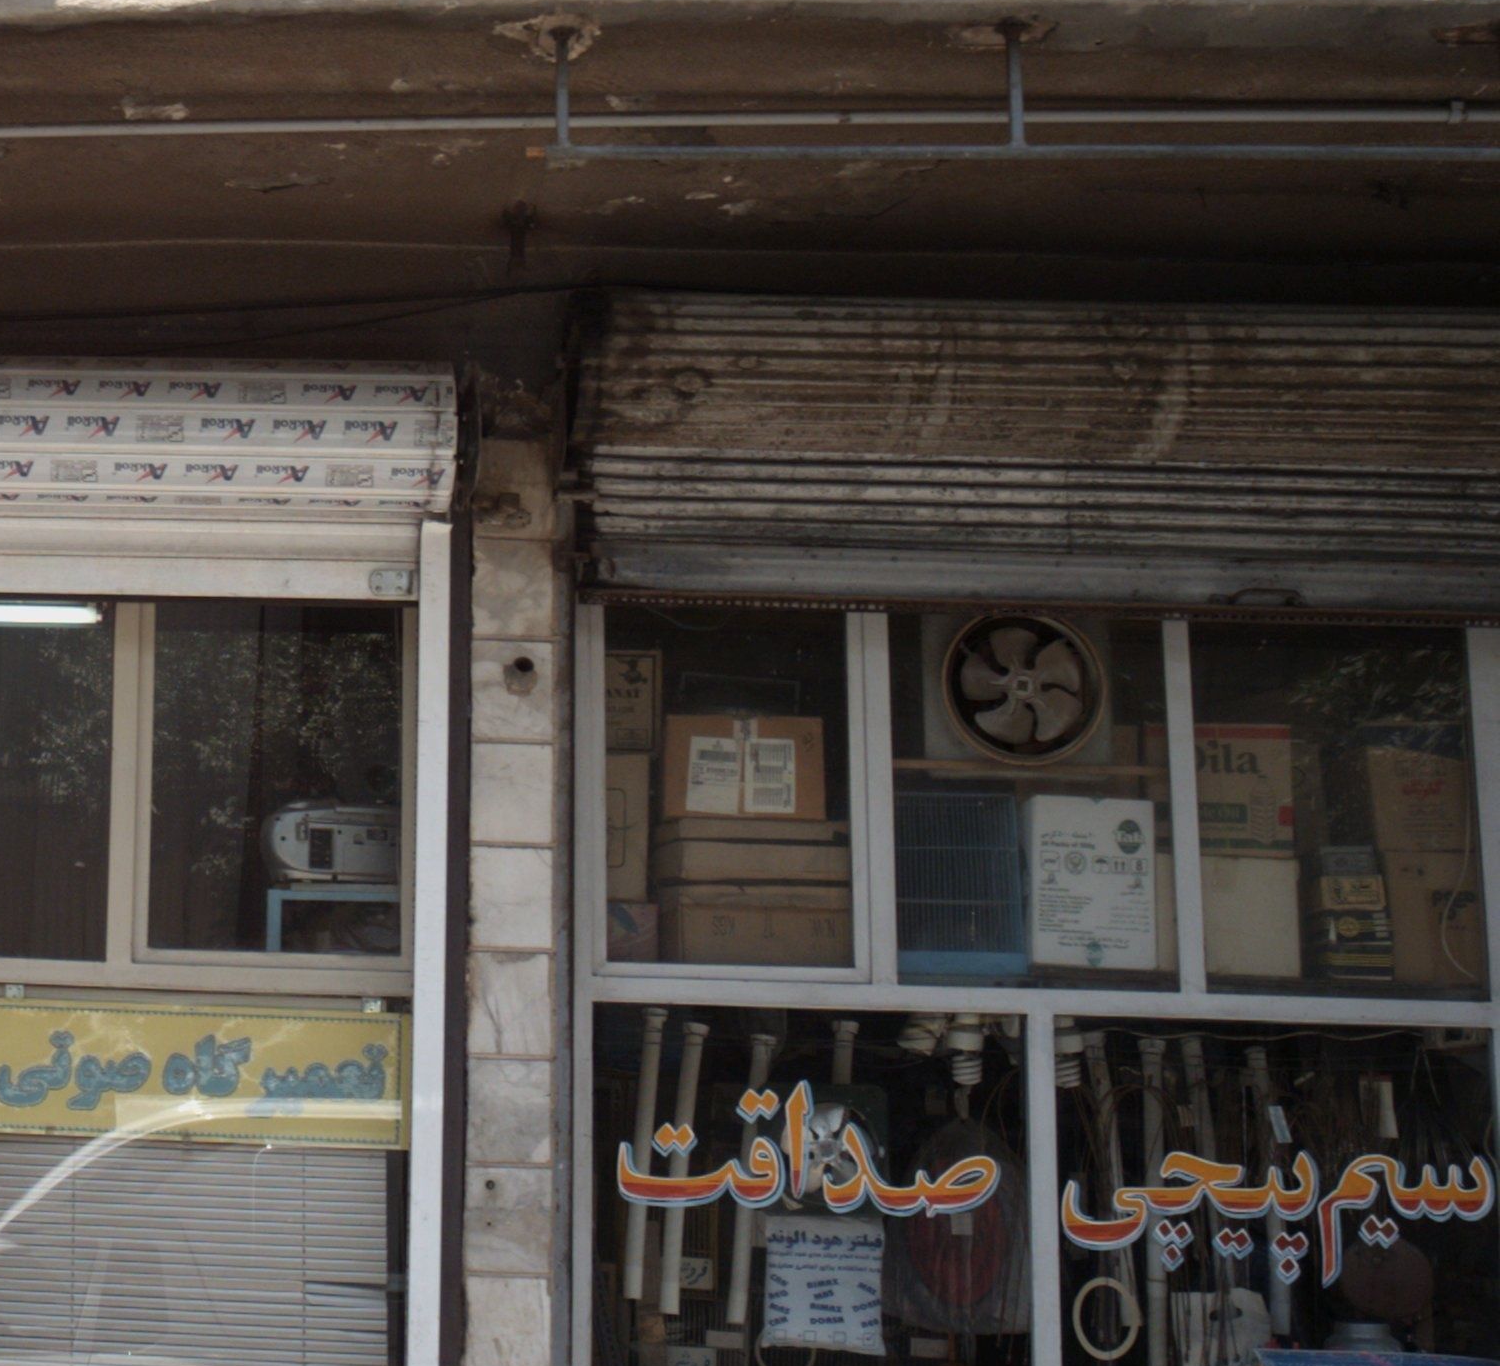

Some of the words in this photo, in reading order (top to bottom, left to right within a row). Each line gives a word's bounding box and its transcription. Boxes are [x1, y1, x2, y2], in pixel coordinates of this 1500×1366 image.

[617, 1080, 1002, 1218] صداقت
[1061, 1148, 1318, 1285] پیچی
[812, 1234, 843, 1251] هود
[1317, 1150, 1496, 1287] سیم
